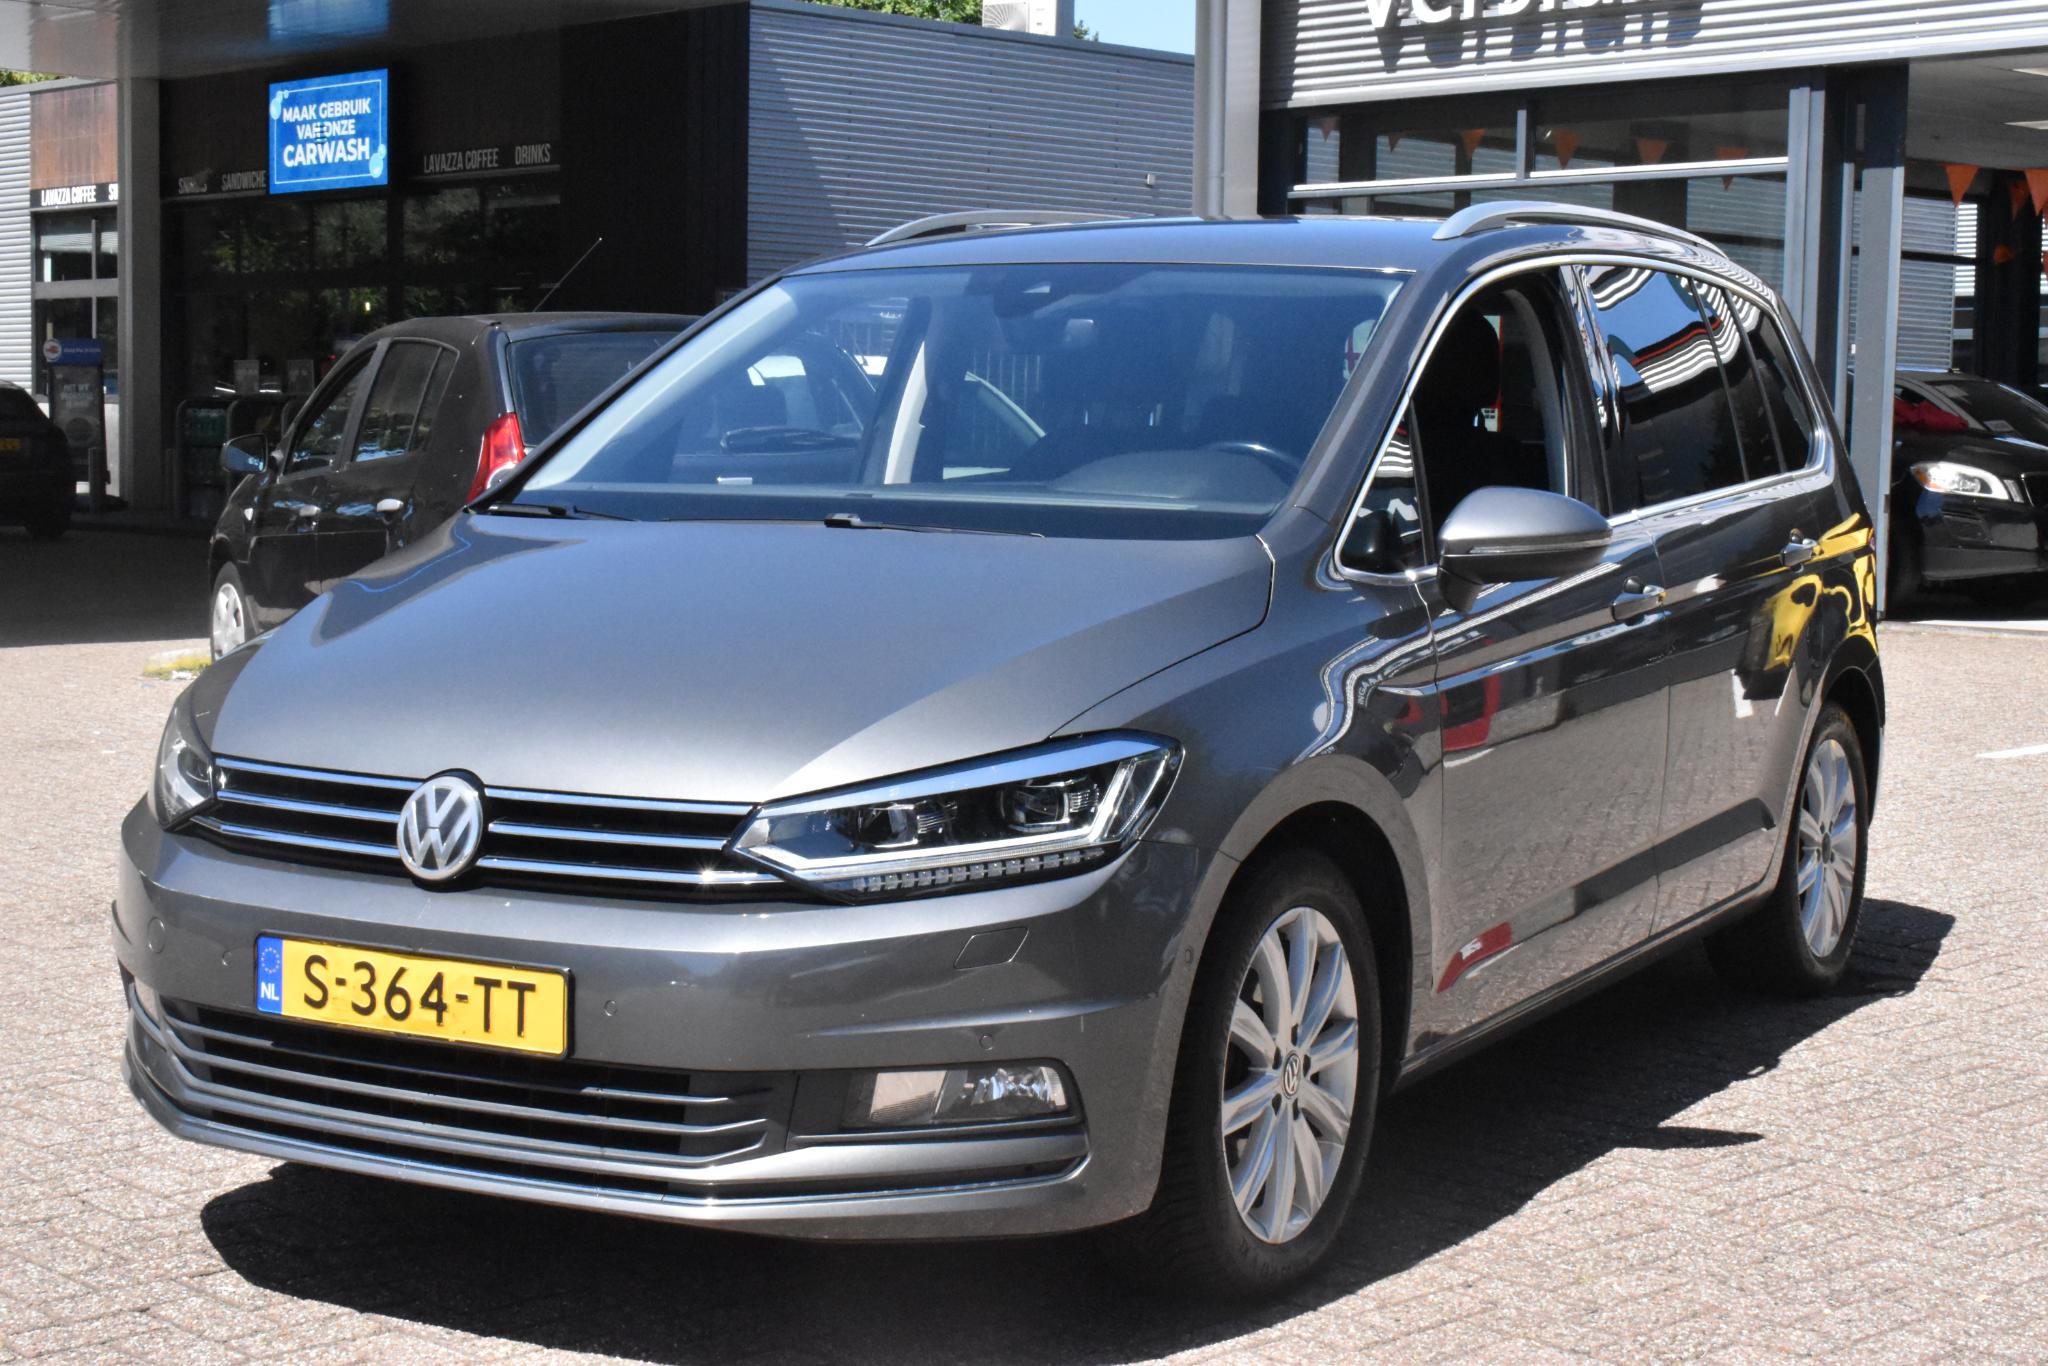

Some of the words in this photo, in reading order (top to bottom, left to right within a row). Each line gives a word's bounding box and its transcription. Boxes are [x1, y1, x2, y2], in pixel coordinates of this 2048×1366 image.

[283, 104, 317, 123] MAAK
[319, 97, 371, 119] GEBRUIK
[283, 137, 370, 168] CARWASH
[423, 152, 463, 173] LAVAZZA
[465, 148, 499, 170] COFFEE
[515, 143, 551, 165] DRINKS
[41, 188, 71, 206] LAVAZZA
[71, 185, 97, 204] COFFEE
[260, 981, 280, 1001] NL
[303, 954, 536, 1038] S-364-TT
